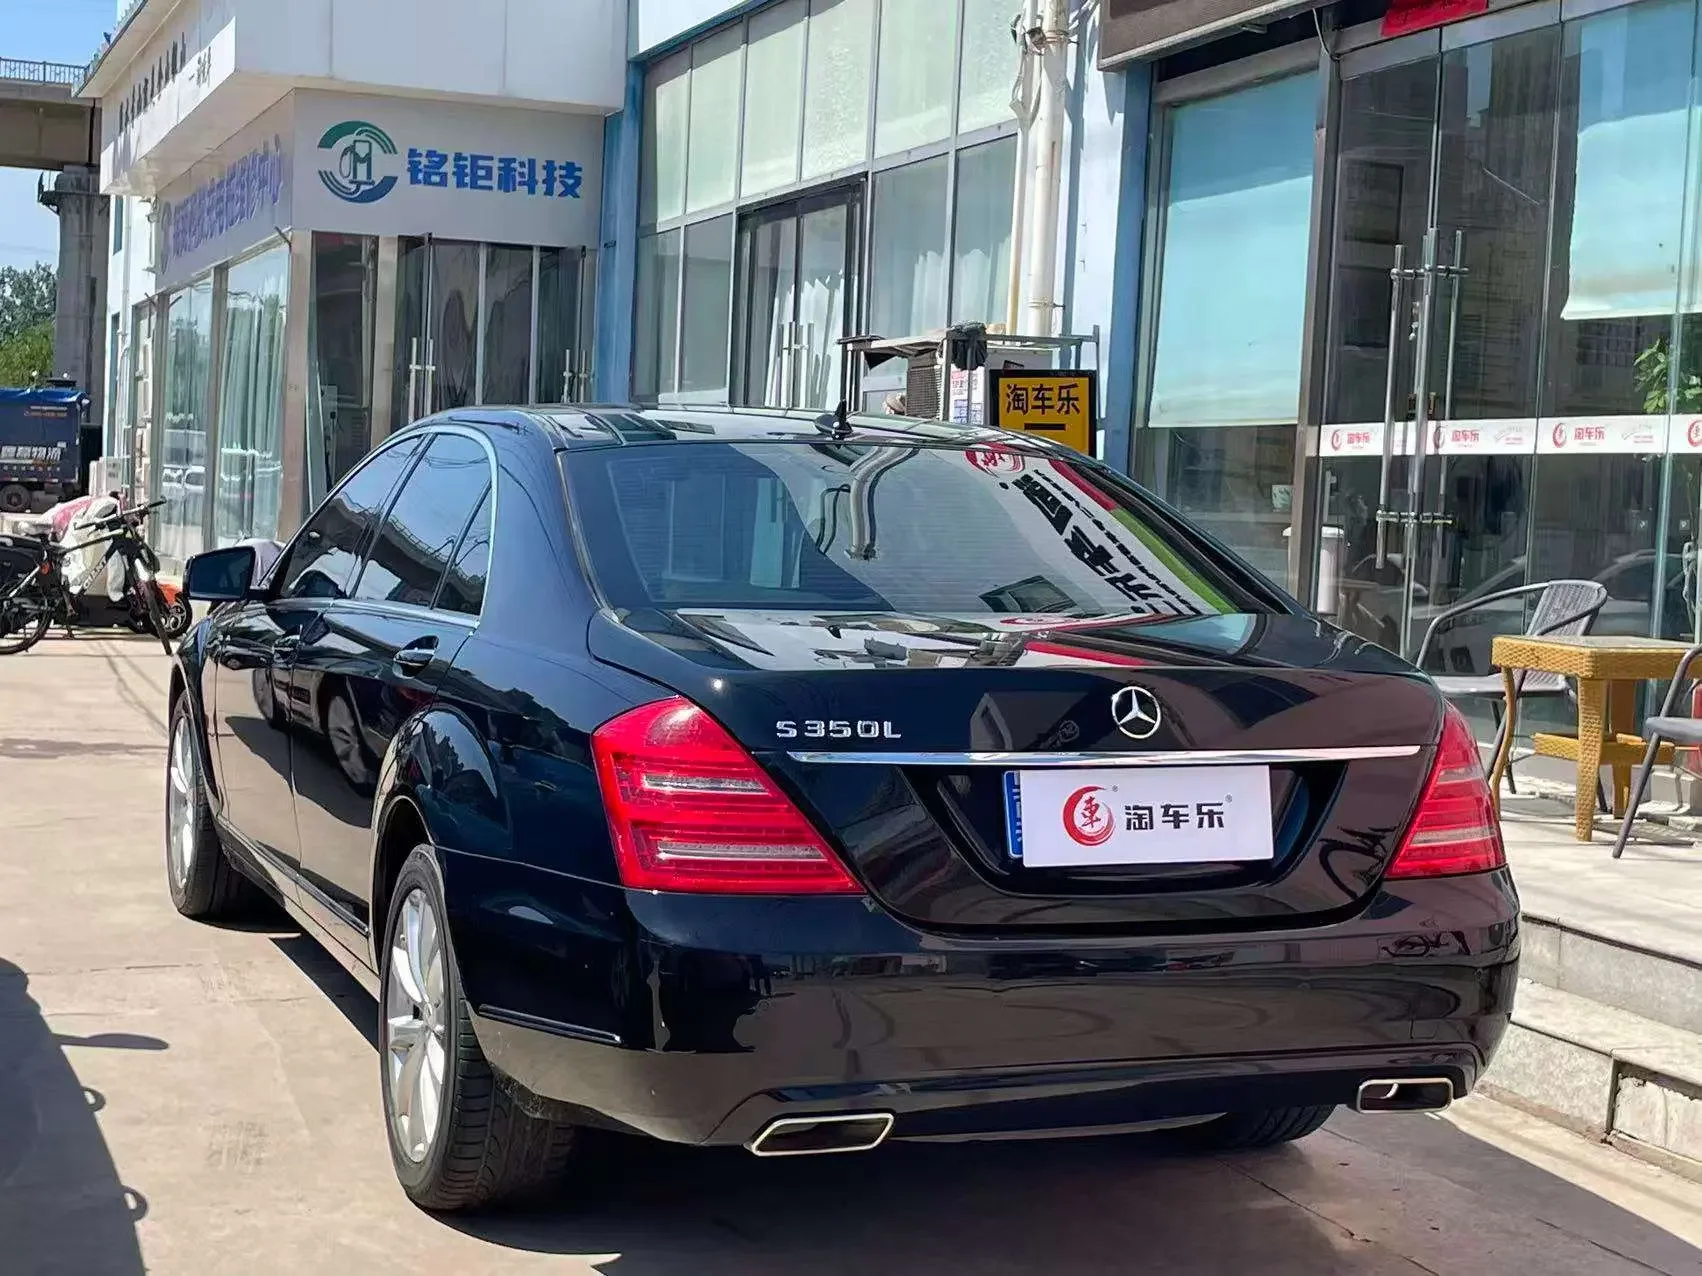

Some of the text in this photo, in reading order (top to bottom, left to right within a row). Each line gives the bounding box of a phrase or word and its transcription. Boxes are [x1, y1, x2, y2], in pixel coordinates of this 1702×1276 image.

[407, 148, 583, 198] 铭钜科技
[1006, 383, 1080, 415] 淘车乐
[776, 720, 902, 739] S350L
[1124, 802, 1225, 831] 淘车乐
